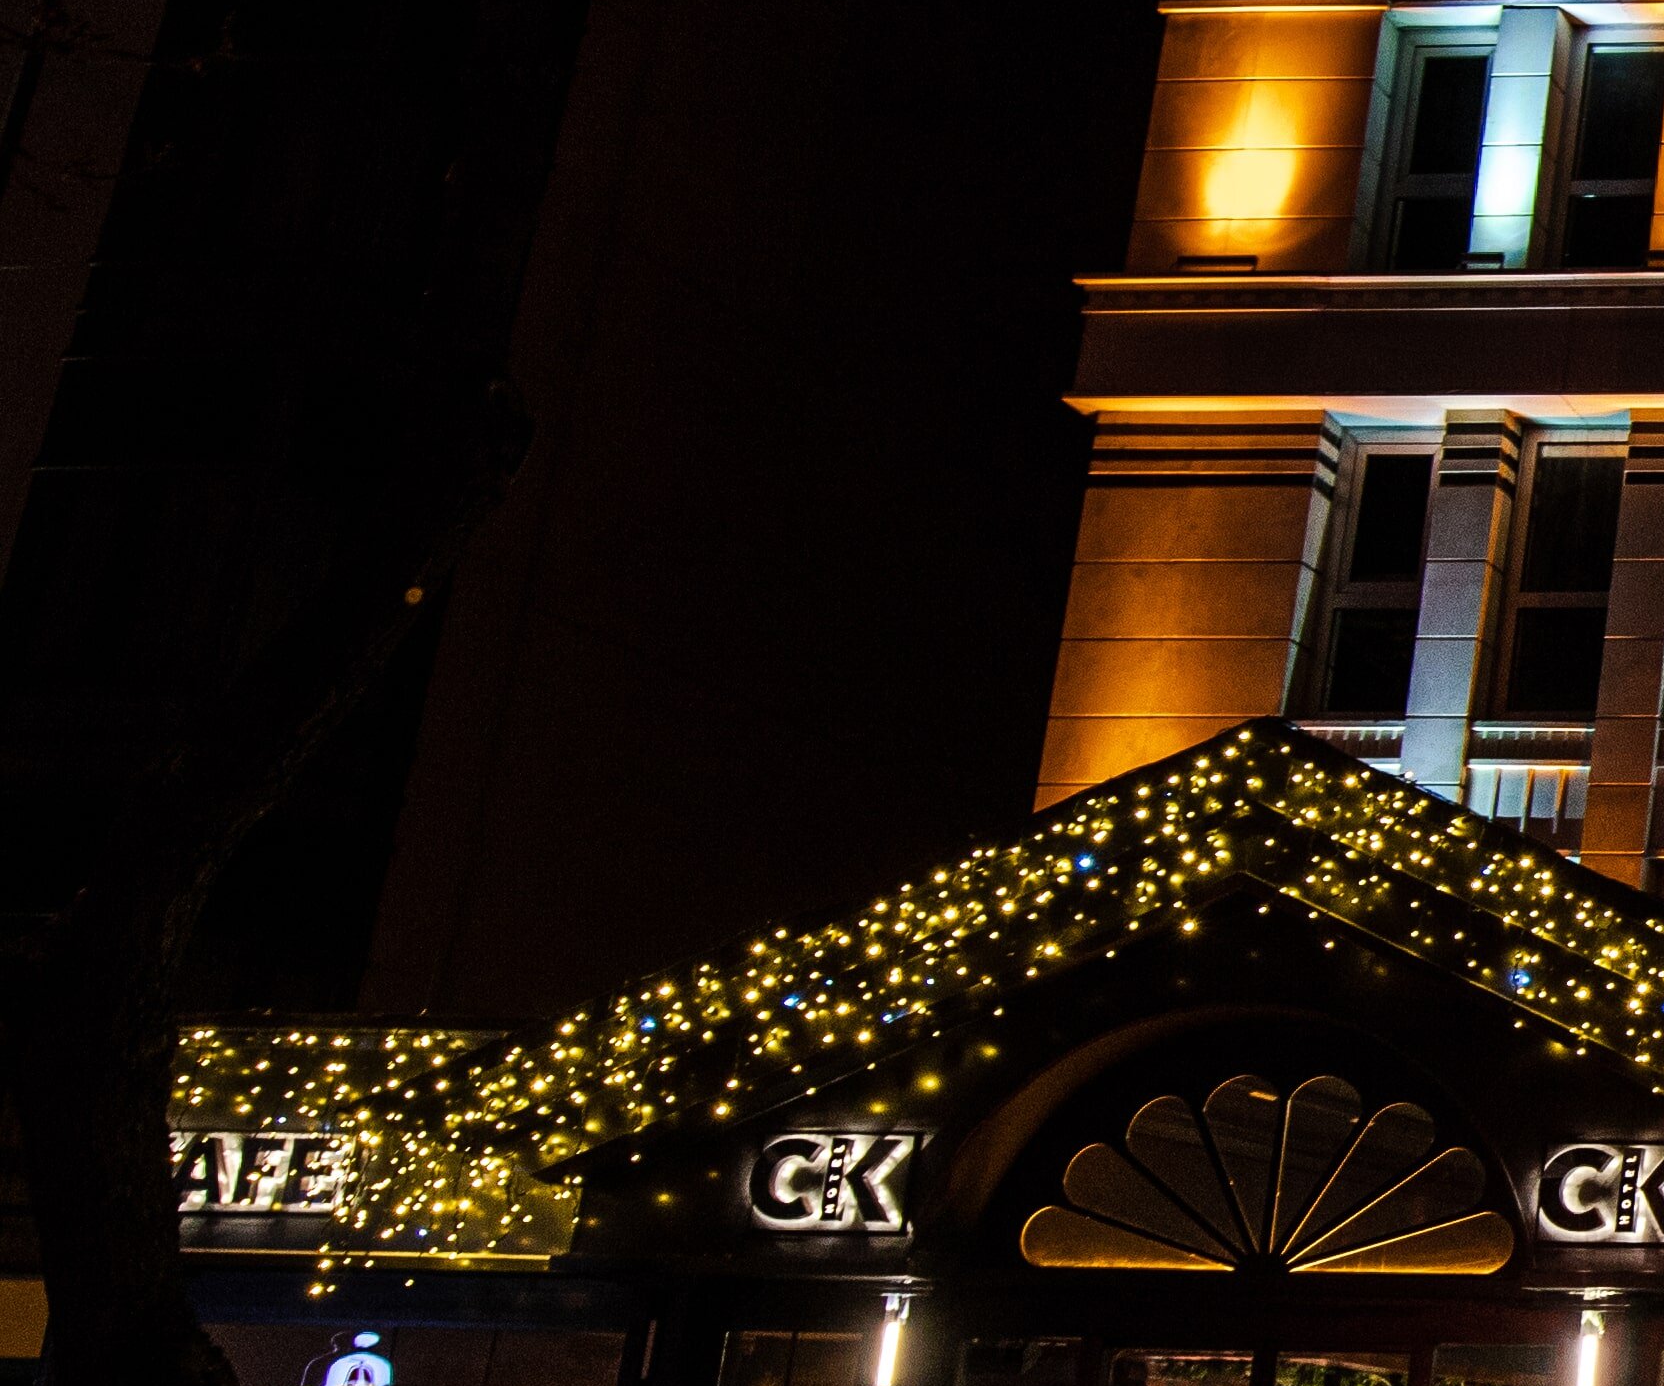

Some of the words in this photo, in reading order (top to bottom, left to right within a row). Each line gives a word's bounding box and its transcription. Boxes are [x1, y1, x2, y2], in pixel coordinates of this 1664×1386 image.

[174, 1131, 344, 1209] AFE
[749, 1138, 904, 1223] CK
[1618, 1154, 1639, 1226] HOTEL
